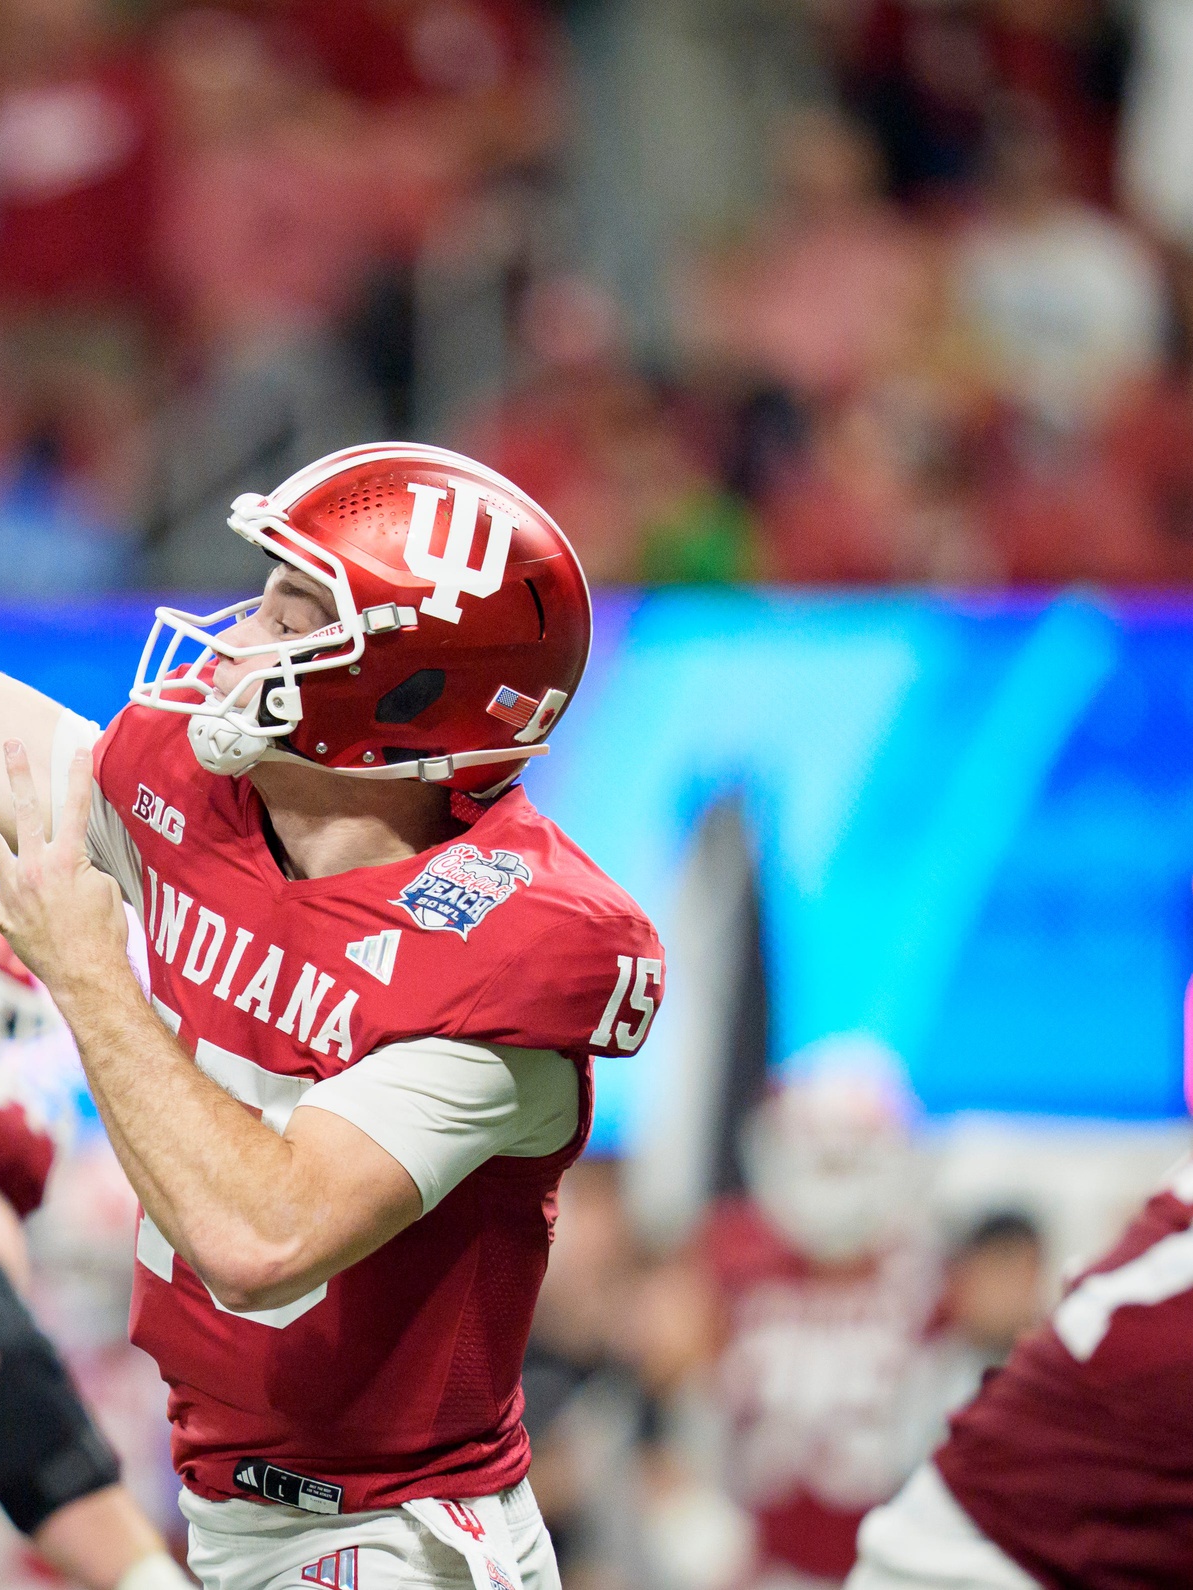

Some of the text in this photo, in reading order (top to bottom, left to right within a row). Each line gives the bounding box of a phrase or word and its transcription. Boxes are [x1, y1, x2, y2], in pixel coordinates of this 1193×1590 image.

[405, 873, 496, 920] PEACH
[415, 897, 460, 921] BOWL
[147, 866, 360, 1062] INDIANA
[589, 955, 662, 1051] 15
